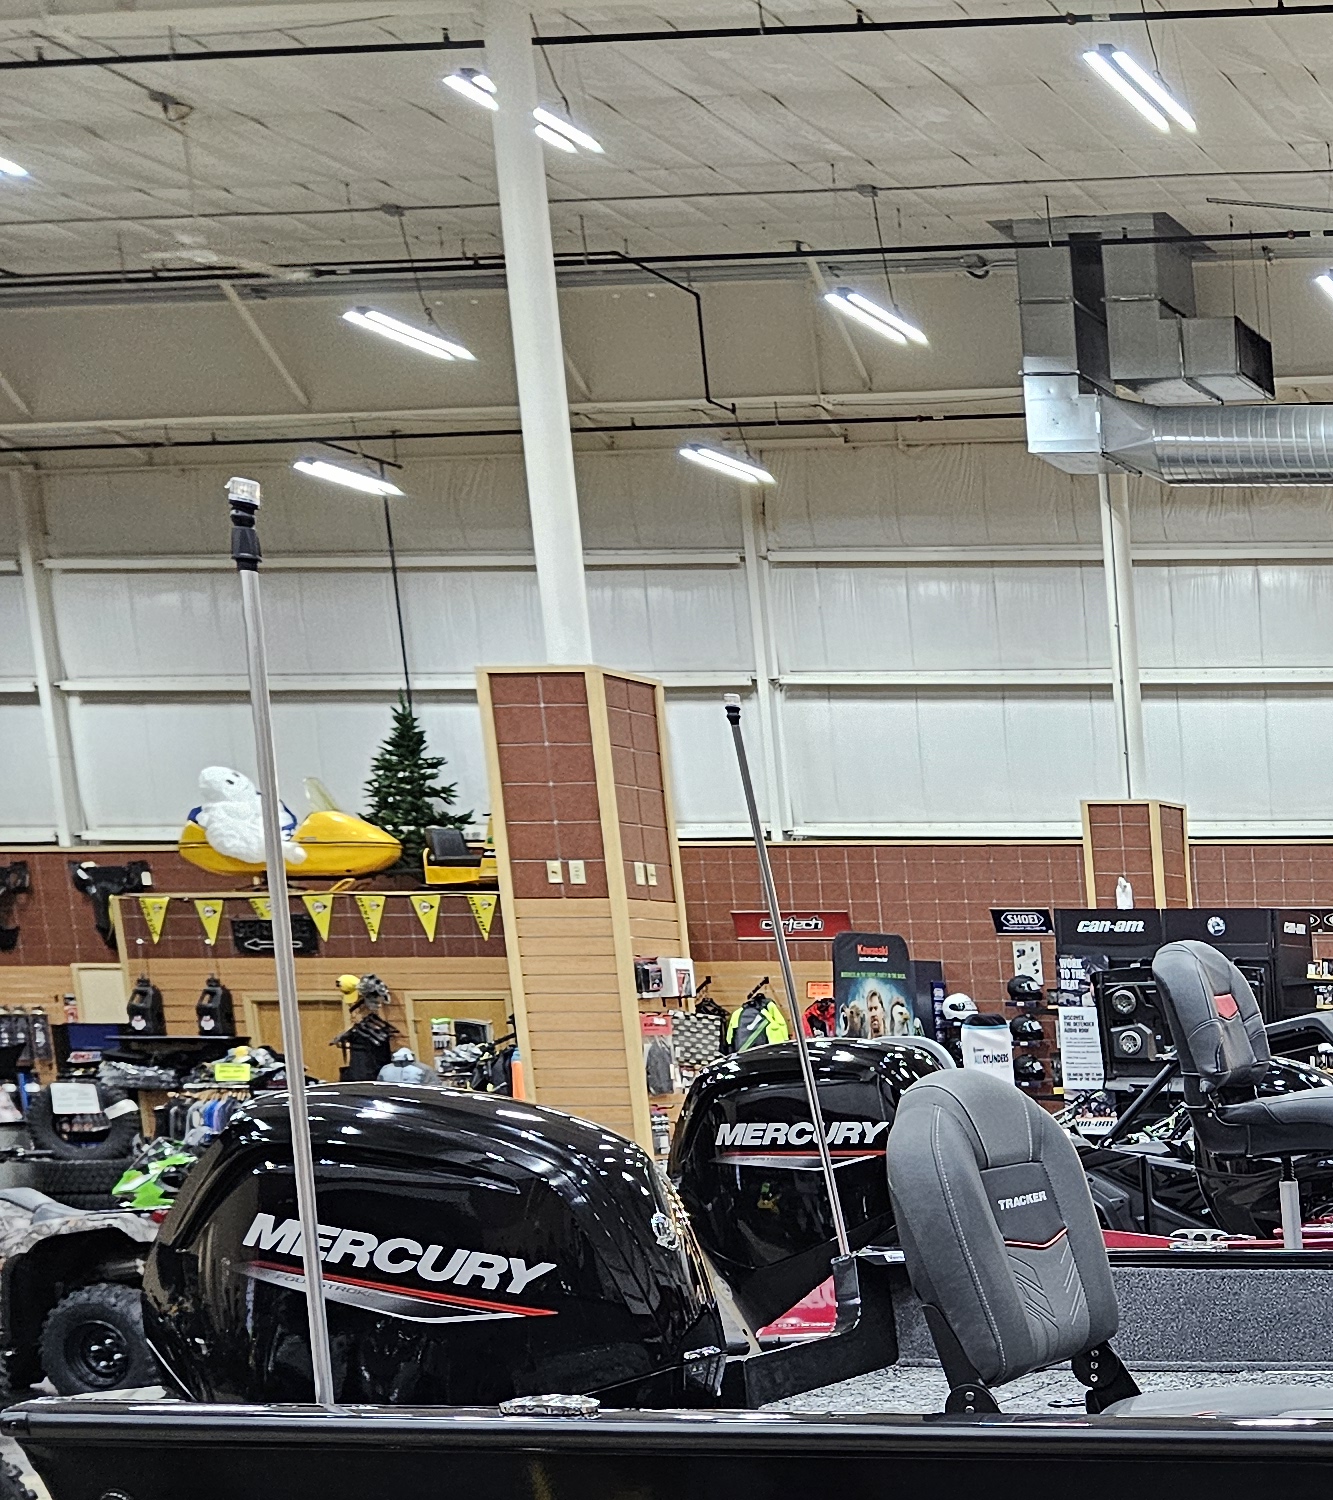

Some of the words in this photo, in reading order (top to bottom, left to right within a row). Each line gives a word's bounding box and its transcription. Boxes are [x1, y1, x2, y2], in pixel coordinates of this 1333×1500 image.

[761, 916, 823, 933] crtech
[1006, 914, 1039, 924] SHOEI
[715, 1121, 890, 1146] MERCURY
[997, 1190, 1048, 1211] TRACKER
[242, 1212, 557, 1295] MERCURY
